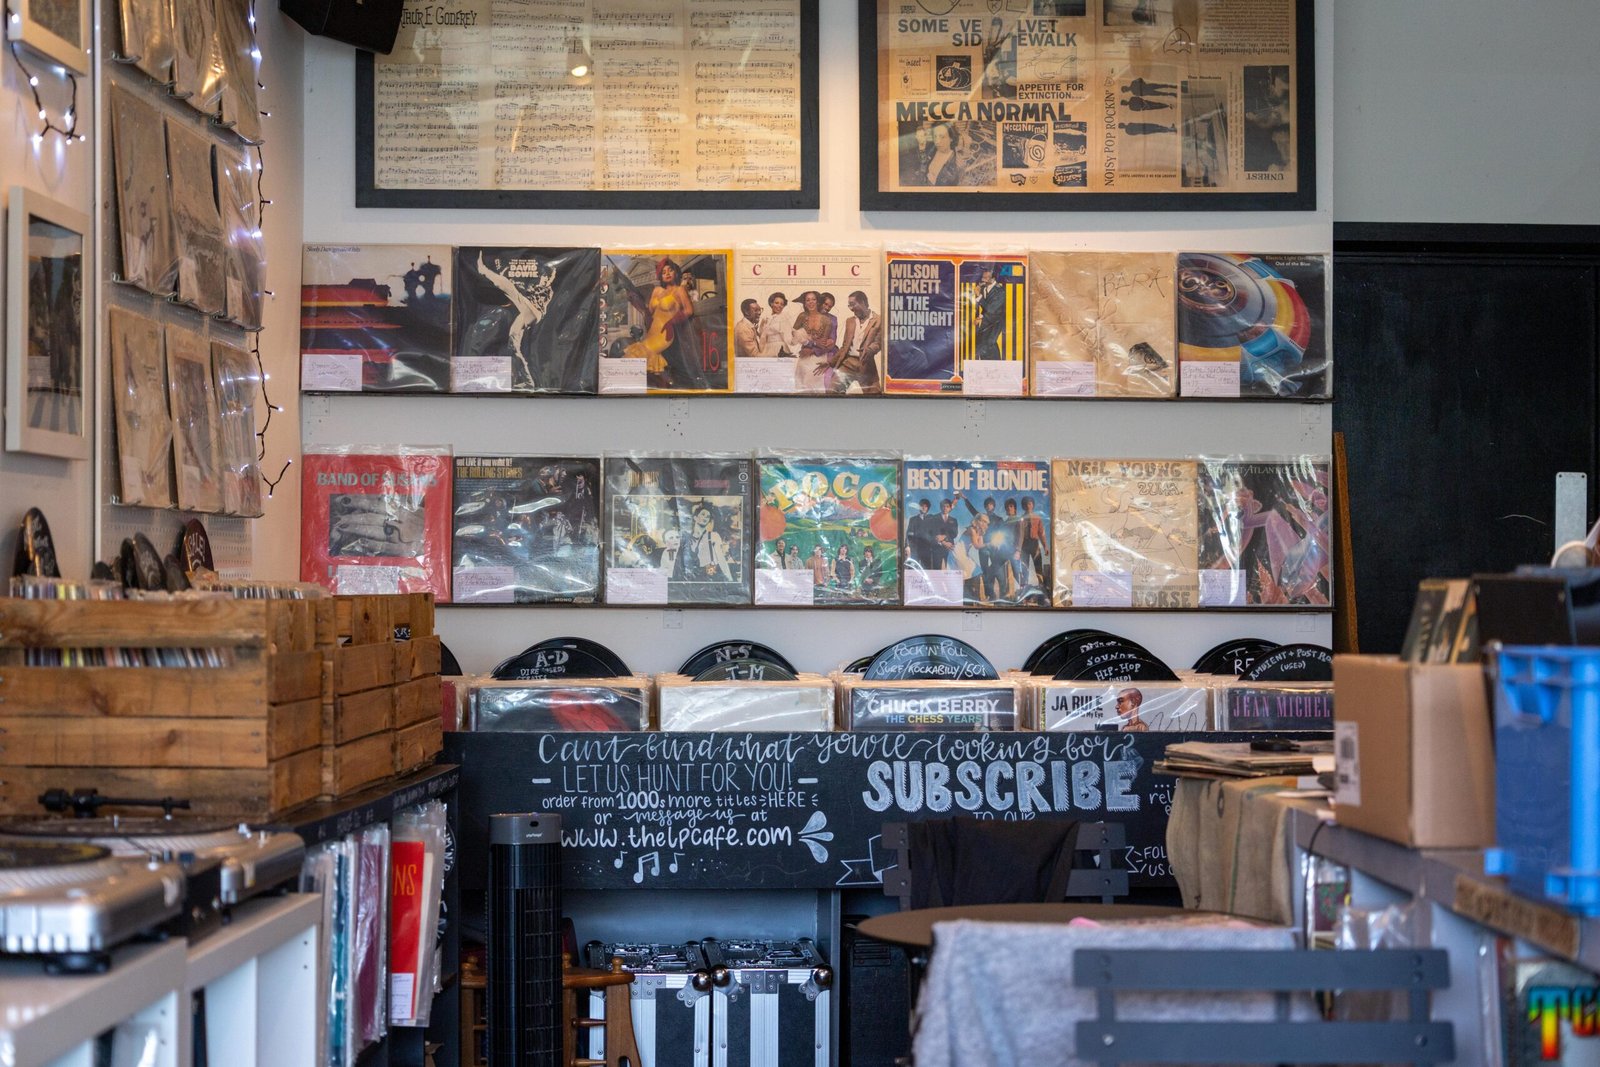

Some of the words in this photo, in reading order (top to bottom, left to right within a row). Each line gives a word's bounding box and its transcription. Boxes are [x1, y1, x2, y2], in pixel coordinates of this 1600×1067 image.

[898, 19, 949, 33] SOME
[960, 20, 982, 33] VE
[1017, 20, 1058, 33] LVET
[952, 33, 982, 47] SID
[1017, 33, 1077, 47] EWALK
[896, 102, 972, 122] MECCA
[977, 102, 1072, 122] NORMAL
[1104, 133, 1116, 154] POP
[1246, 173, 1284, 181] UNREST
[890, 264, 939, 279] WILSON
[890, 279, 941, 294] PICKETT
[890, 296, 904, 310] IN
[906, 296, 929, 311] THE
[890, 311, 953, 326] MIDNIGHT
[890, 326, 925, 341] HOUR
[702, 331, 720, 372] 16
[456, 467, 469, 478] THE
[470, 467, 495, 478] ROLLING
[497, 467, 523, 478] STONES
[1119, 462, 1182, 477] YOUNG
[316, 472, 358, 486] BAND
[360, 473, 379, 486] OF
[907, 468, 950, 490] BEST
[953, 469, 974, 490] OF
[977, 469, 1048, 491] BLONDIE
[769, 471, 888, 513] POCO
[893, 643, 924, 659] ROCK
[940, 640, 968, 660] ROLL
[535, 650, 569, 668] A-D
[1249, 651, 1288, 681] AMBIENT
[1296, 649, 1318, 658] POST
[520, 668, 540, 676] DIRE
[868, 699, 931, 713] CHUCK
[938, 699, 1000, 713] BERRY
[1051, 695, 1068, 711] JA
[1233, 695, 1270, 717] JEAN
[1277, 695, 1331, 718] MICHEL
[885, 715, 905, 724] THE
[908, 714, 944, 724] CHESS
[947, 714, 983, 724] YEARS
[719, 733, 804, 763] what
[925, 733, 1057, 763] looking
[563, 764, 603, 792] LET
[606, 764, 630, 793] US
[638, 763, 695, 792] HUNT
[701, 762, 740, 792] FOR
[744, 762, 793, 792] YOU!
[862, 760, 1141, 812] SUBSCRIBE
[542, 795, 578, 809] order
[581, 795, 614, 808] from
[668, 795, 711, 808] more
[716, 794, 757, 807] titles
[768, 791, 806, 808] HERE
[1149, 790, 1174, 805] rel
[594, 812, 613, 825] or
[623, 809, 711, 828] message
[751, 809, 768, 822] at
[1143, 846, 1168, 860] FOL
[1148, 863, 1165, 877] US
